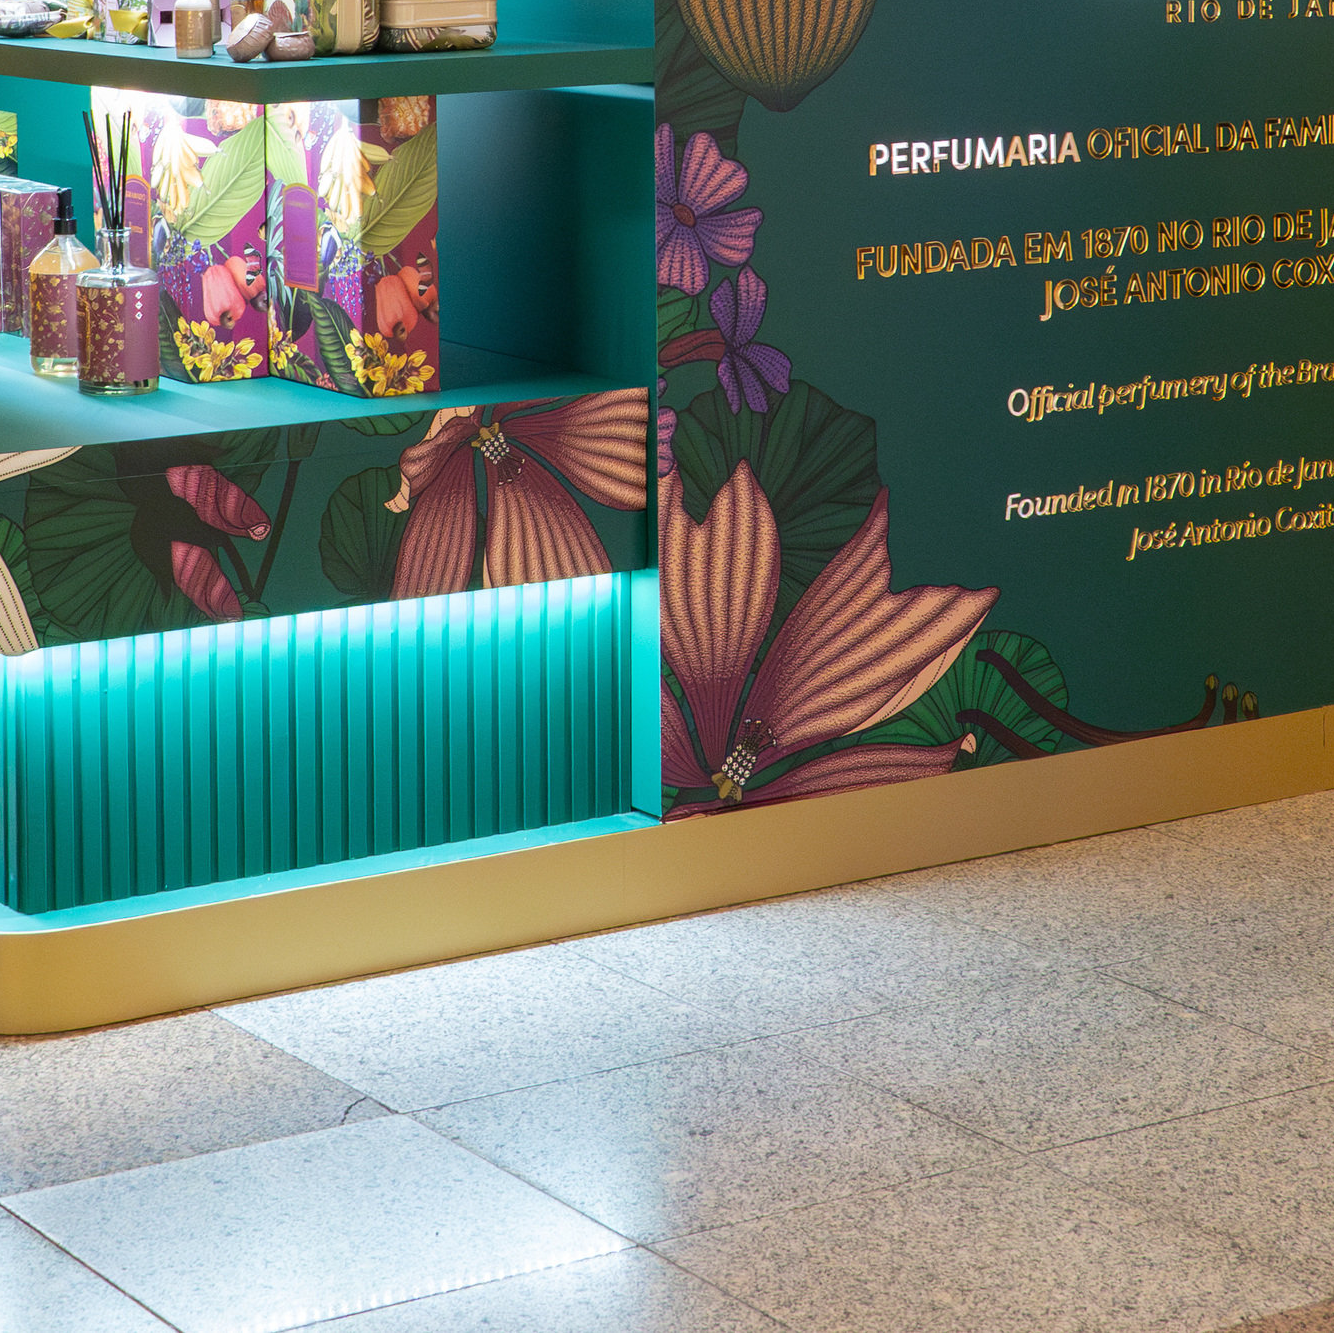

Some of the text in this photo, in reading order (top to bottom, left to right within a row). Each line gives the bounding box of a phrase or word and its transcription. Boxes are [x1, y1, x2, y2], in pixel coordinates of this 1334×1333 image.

[868, 131, 1081, 177] PERFUMARIA
[1087, 122, 1209, 161] OFICIAL
[1215, 119, 1259, 152] DA
[856, 234, 1017, 281] FUNDADA
[1024, 230, 1074, 265] EM
[1081, 224, 1149, 259] 1870
[1157, 218, 1204, 254] NO
[1212, 213, 1265, 248] RIO
[1273, 208, 1312, 243] DE
[1038, 265, 1118, 322] JOSÉ
[1123, 260, 1265, 305] ANTONIO
[1007, 383, 1094, 422] Official
[1098, 373, 1228, 414] perfumery
[1230, 363, 1257, 398] of
[1258, 362, 1295, 388] the
[1005, 480, 1113, 520] Founded
[1145, 471, 1195, 503] 1870
[1199, 469, 1222, 497] in
[1265, 460, 1295, 487] de
[1126, 522, 1177, 561] José
[1179, 512, 1271, 547] Antonio
